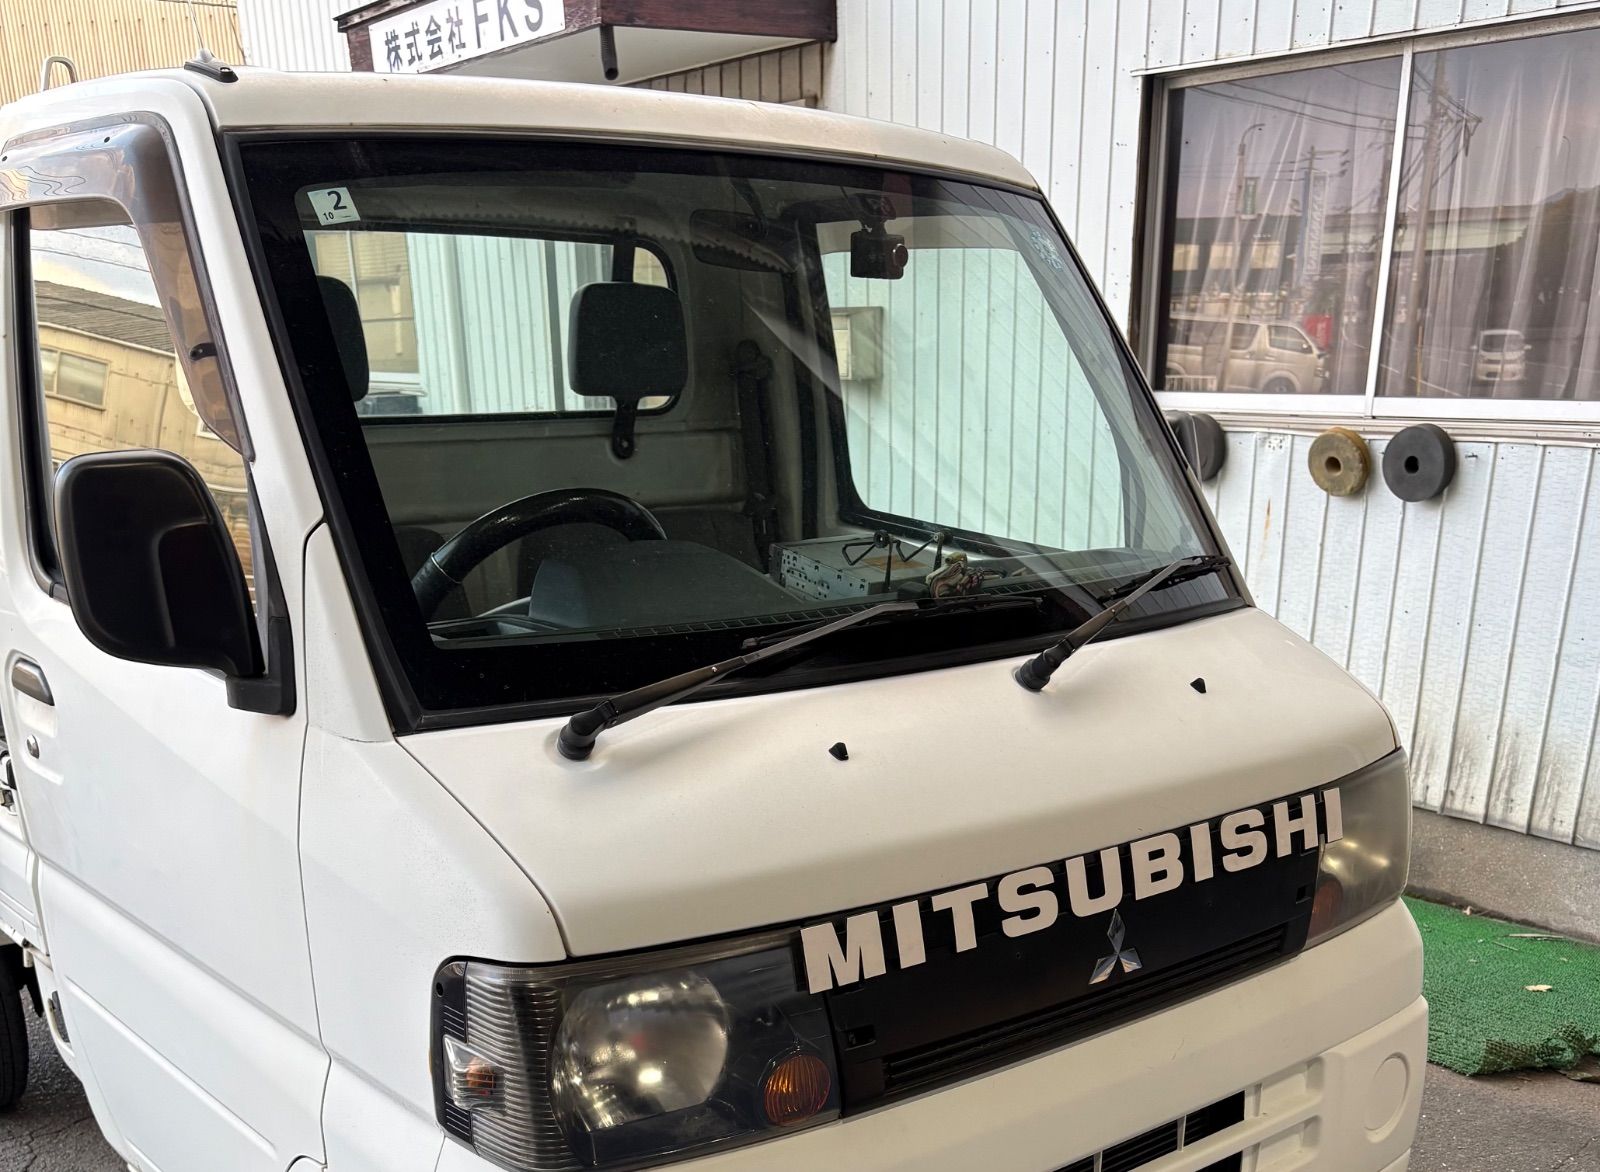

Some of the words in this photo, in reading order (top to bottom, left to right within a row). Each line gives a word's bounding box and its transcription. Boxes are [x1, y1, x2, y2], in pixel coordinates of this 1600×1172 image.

[327, 190, 347, 210] 2
[323, 211, 334, 220] 10
[800, 787, 1343, 994] MITSUBISHI
